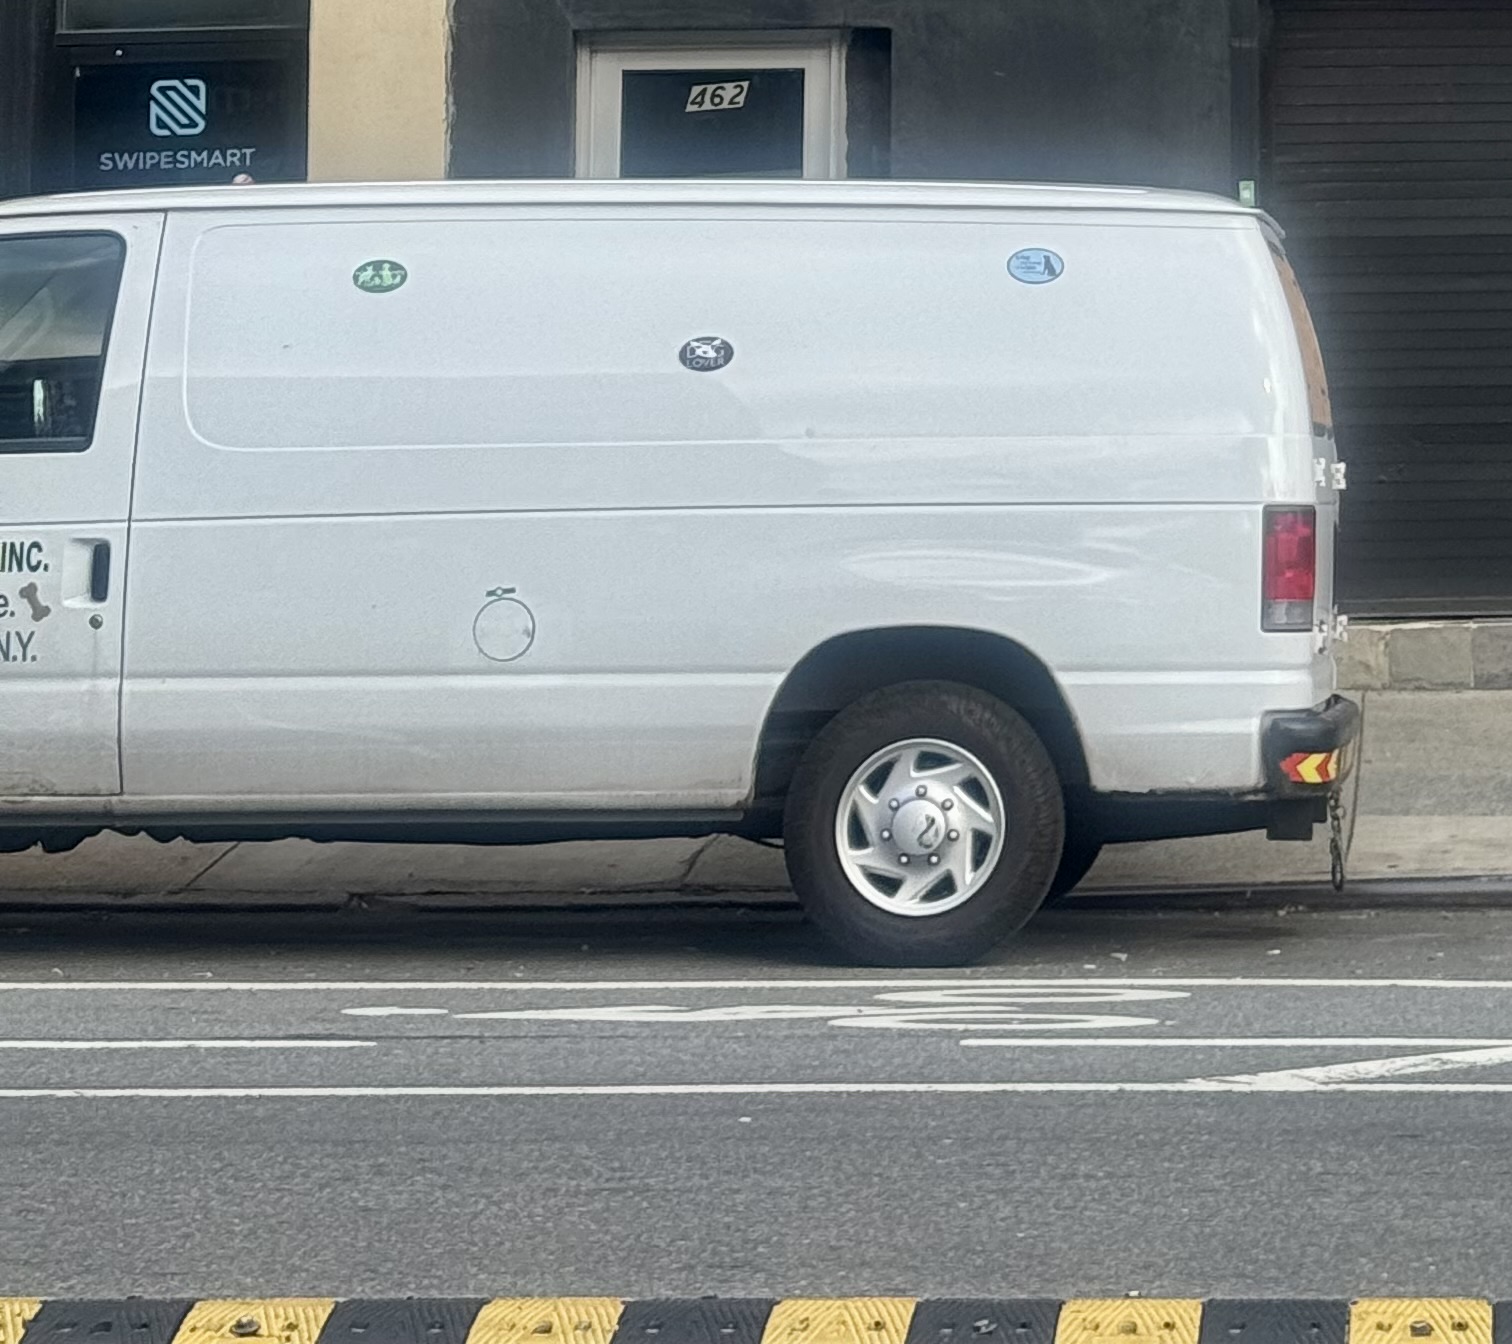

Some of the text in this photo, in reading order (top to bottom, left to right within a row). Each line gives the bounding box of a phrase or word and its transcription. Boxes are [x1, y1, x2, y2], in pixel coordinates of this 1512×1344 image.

[689, 84, 744, 108] 462
[99, 148, 256, 171] SWIPESMART
[0, 541, 49, 573] INC.
[0, 630, 37, 662] N.Y.
